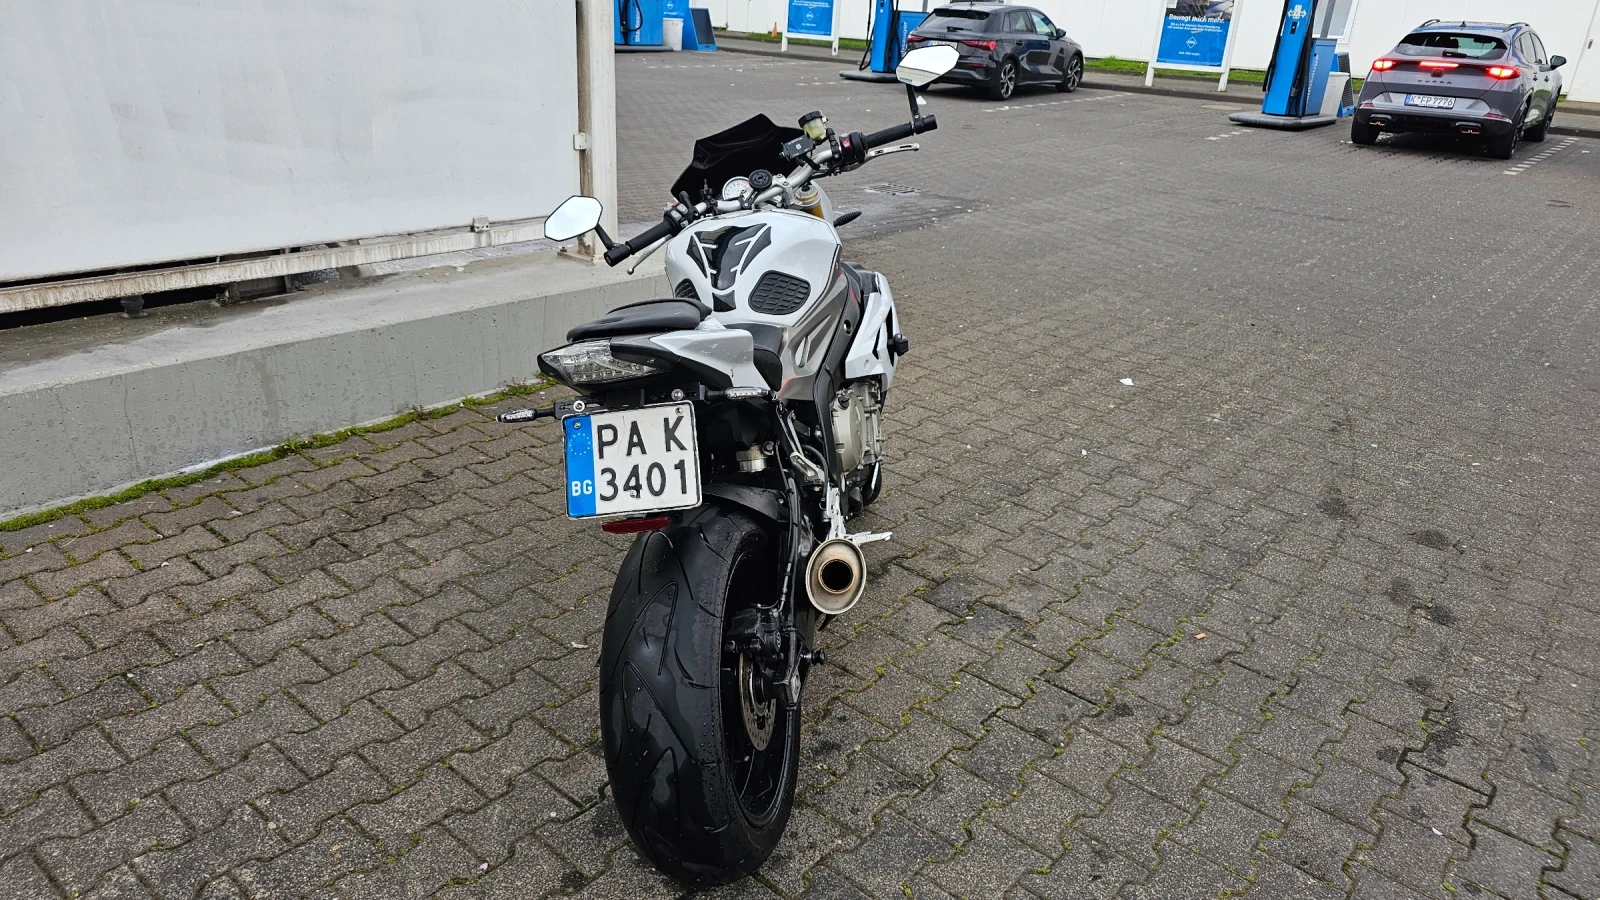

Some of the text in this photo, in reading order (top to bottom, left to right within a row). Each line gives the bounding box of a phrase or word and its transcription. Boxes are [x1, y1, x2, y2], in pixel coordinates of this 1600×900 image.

[1410, 95, 1453, 106] K FP 7776
[597, 415, 688, 460] PA K
[571, 479, 593, 497] BG
[600, 459, 688, 502] 3401
